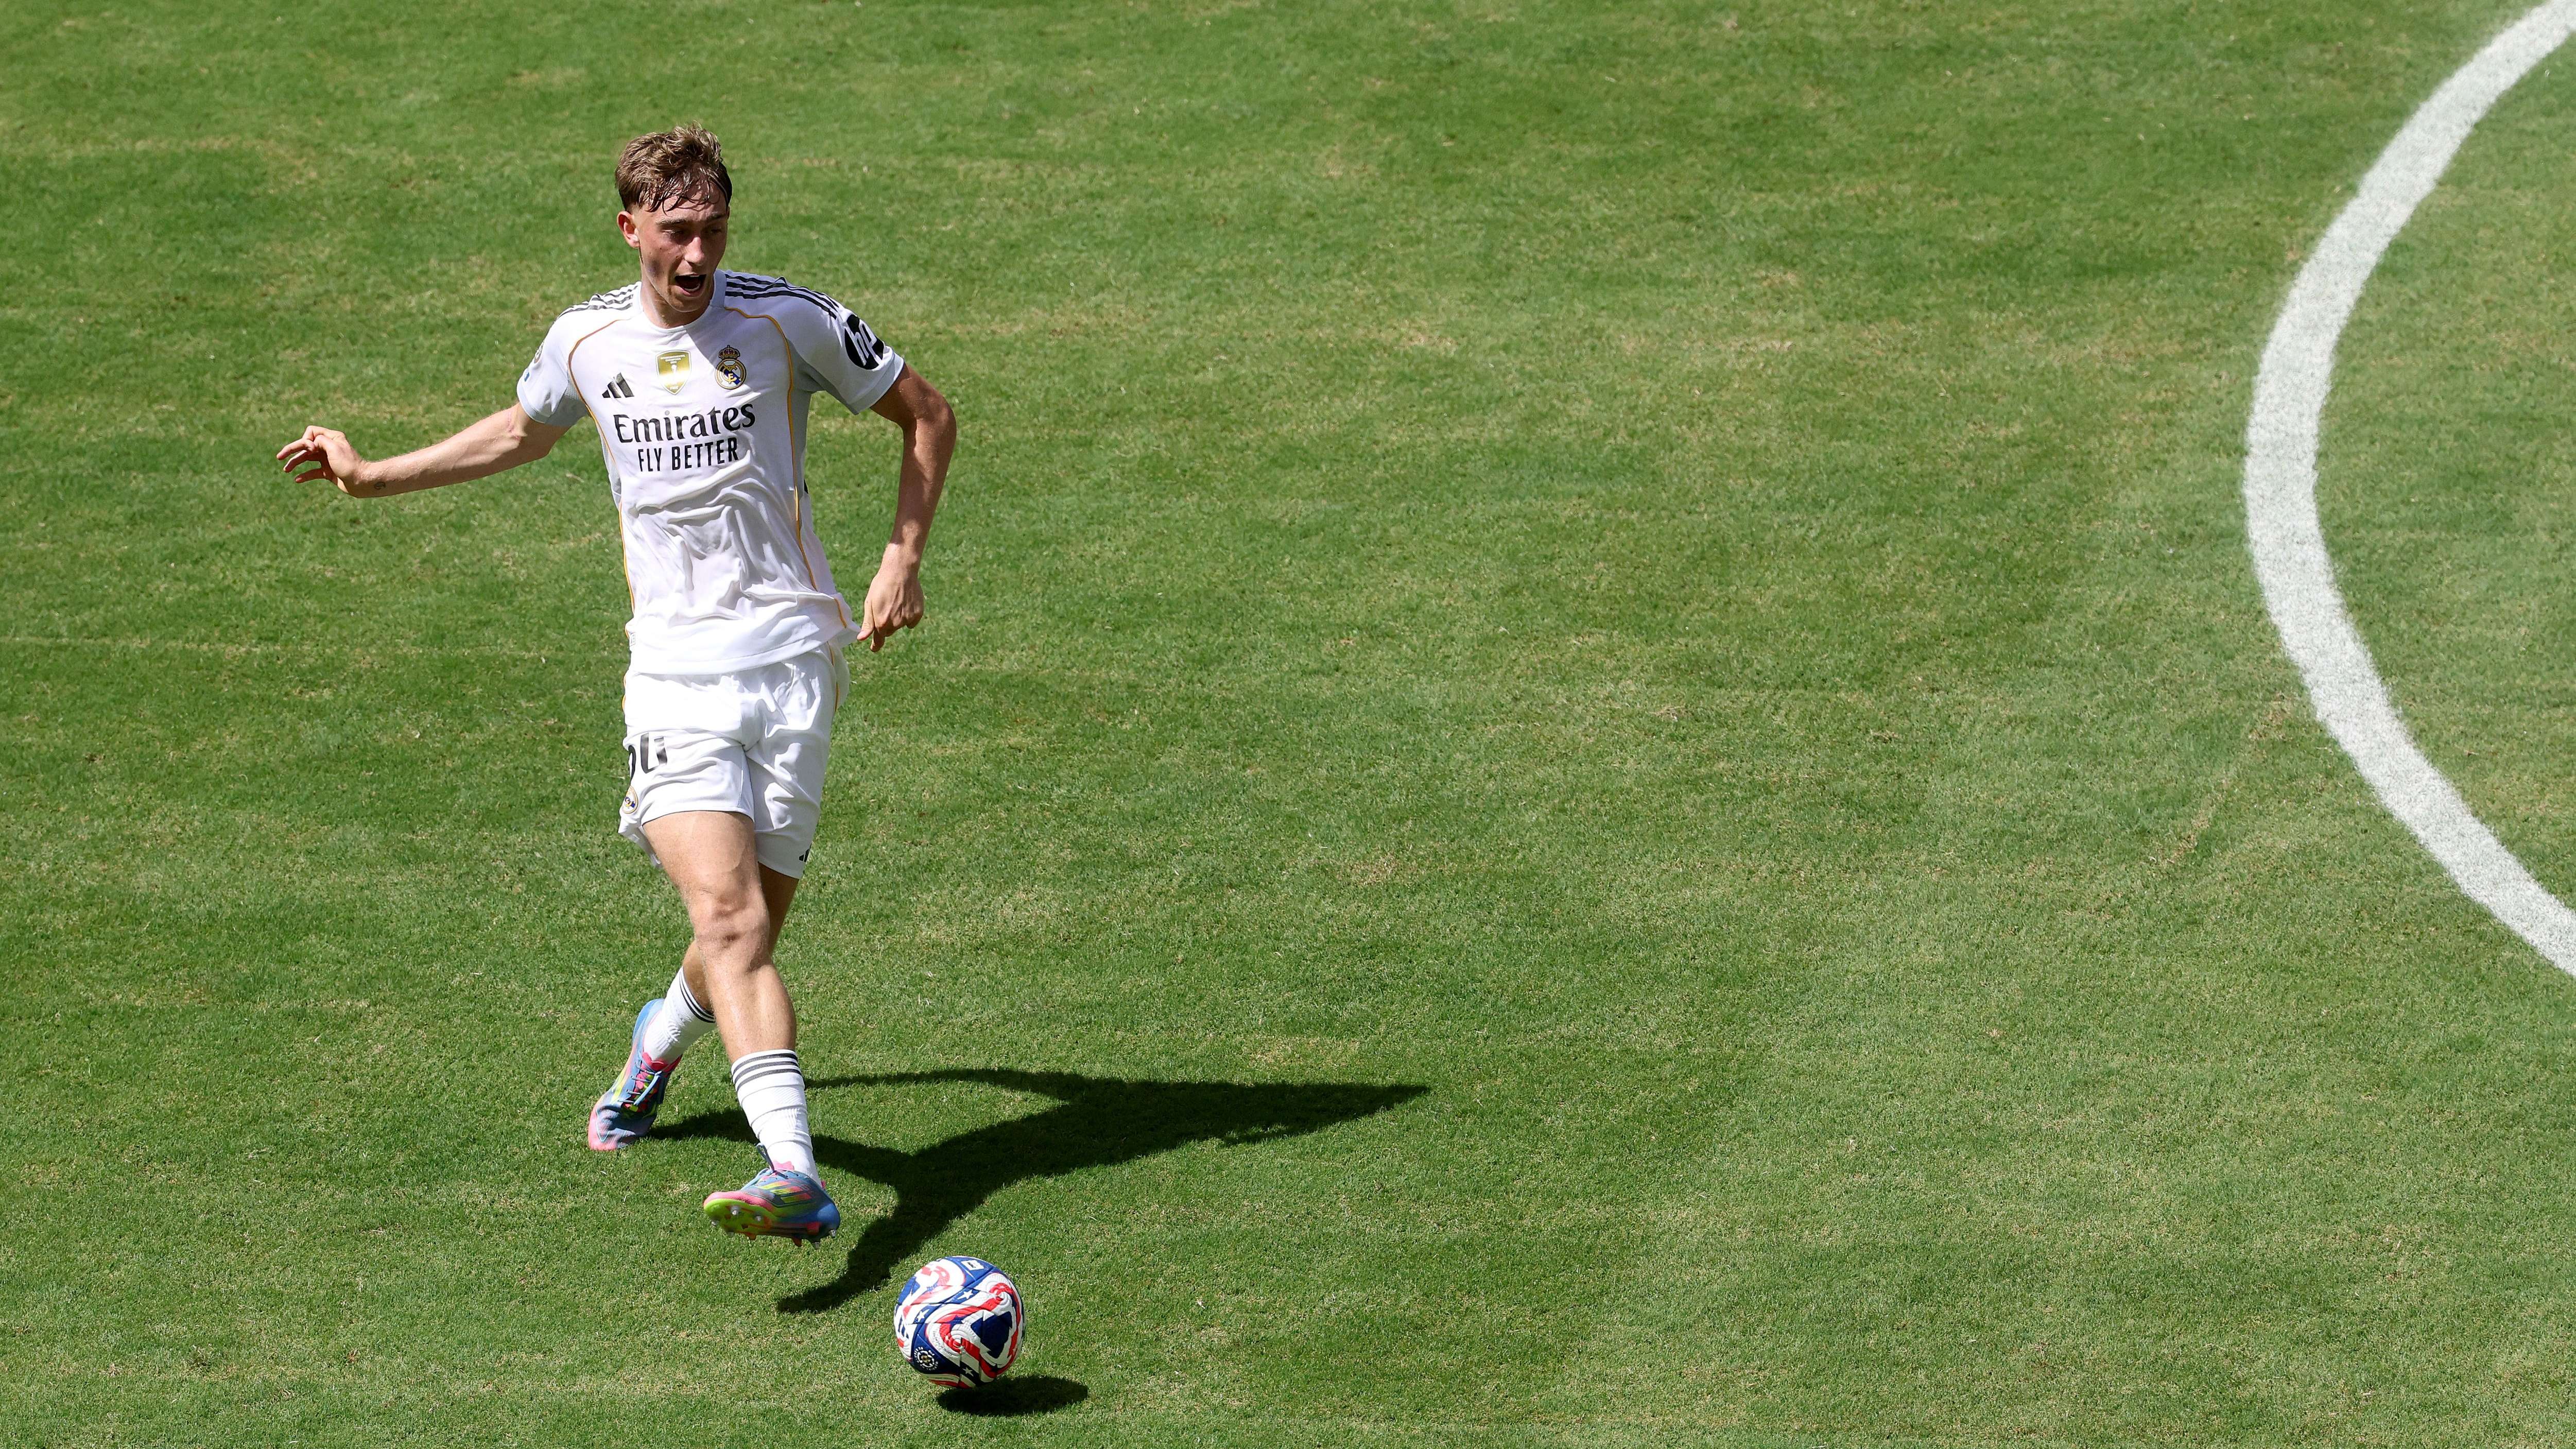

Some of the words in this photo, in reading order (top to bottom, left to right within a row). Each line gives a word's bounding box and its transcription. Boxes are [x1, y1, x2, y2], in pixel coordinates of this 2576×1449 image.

[844, 319, 880, 367] hp
[613, 403, 755, 443] Emirates
[638, 447, 662, 472] FLY
[671, 437, 739, 471] BETTER
